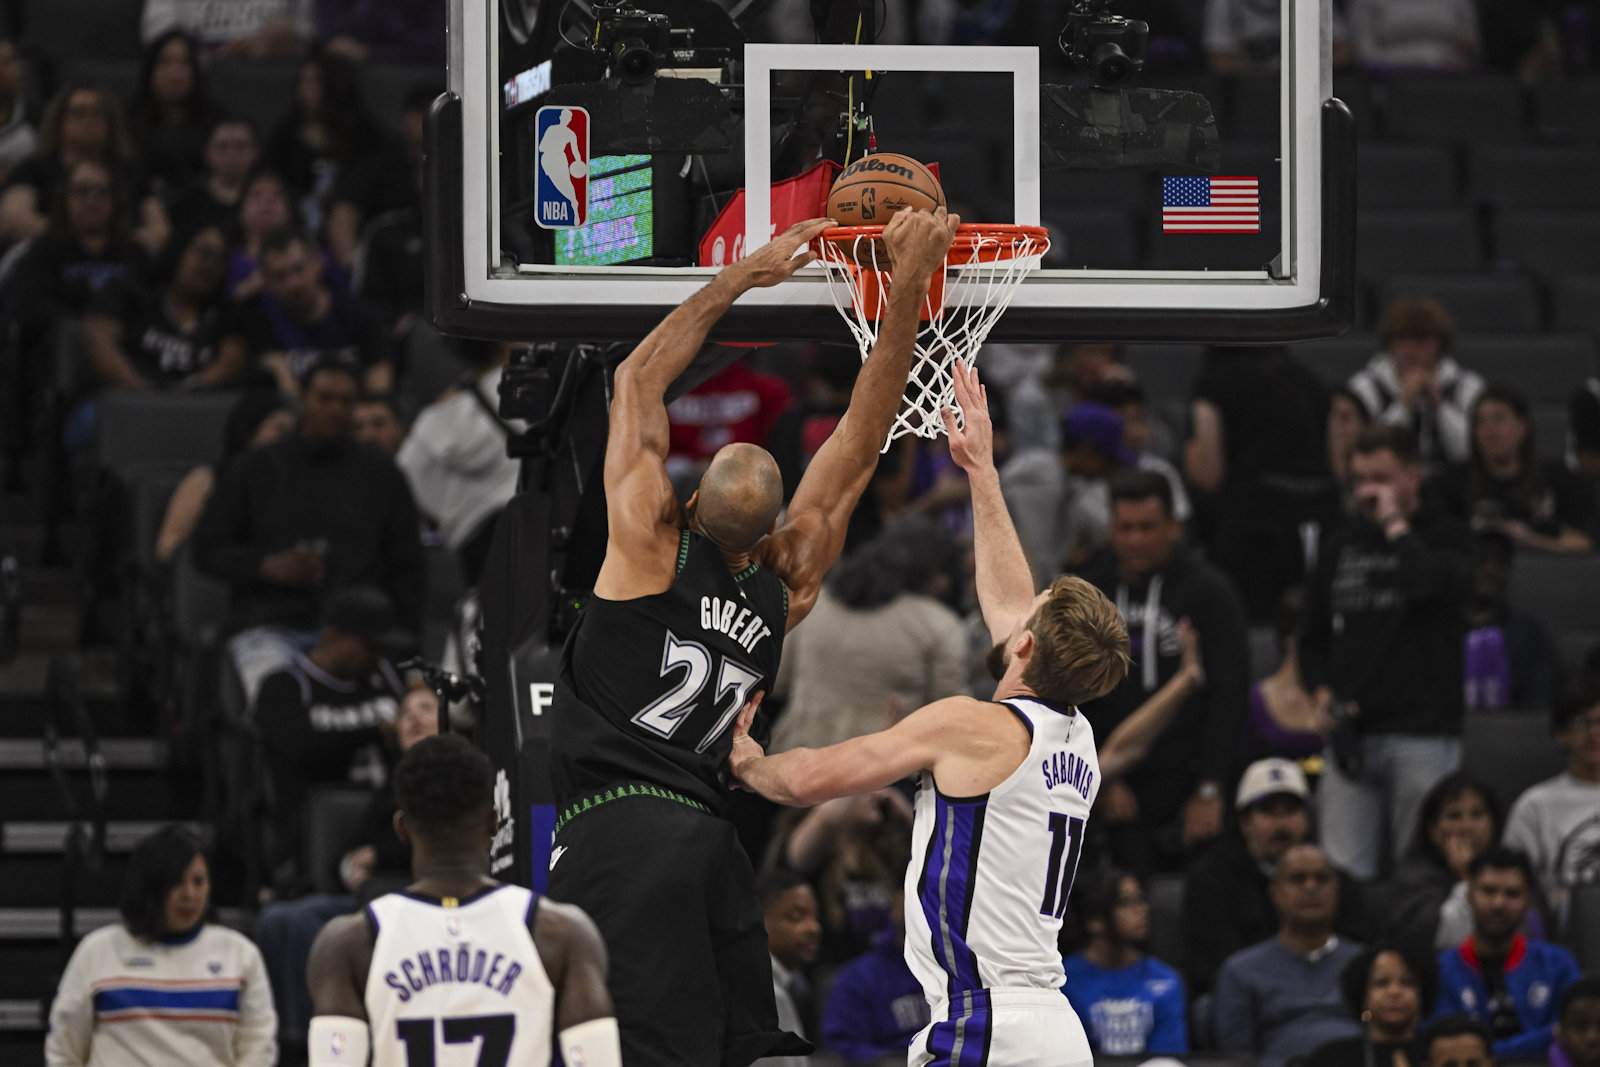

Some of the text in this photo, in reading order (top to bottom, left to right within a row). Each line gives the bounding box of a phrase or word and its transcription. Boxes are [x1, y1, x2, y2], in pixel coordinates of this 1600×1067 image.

[840, 159, 914, 180] Wilson
[543, 201, 568, 220] NBA
[701, 596, 772, 654] GOBERT
[630, 628, 764, 754] 27
[1042, 751, 1093, 800] SABONIS
[1040, 811, 1084, 919] 11
[384, 942, 522, 1002] SCHRÖDER
[395, 1013, 516, 1067] 17
